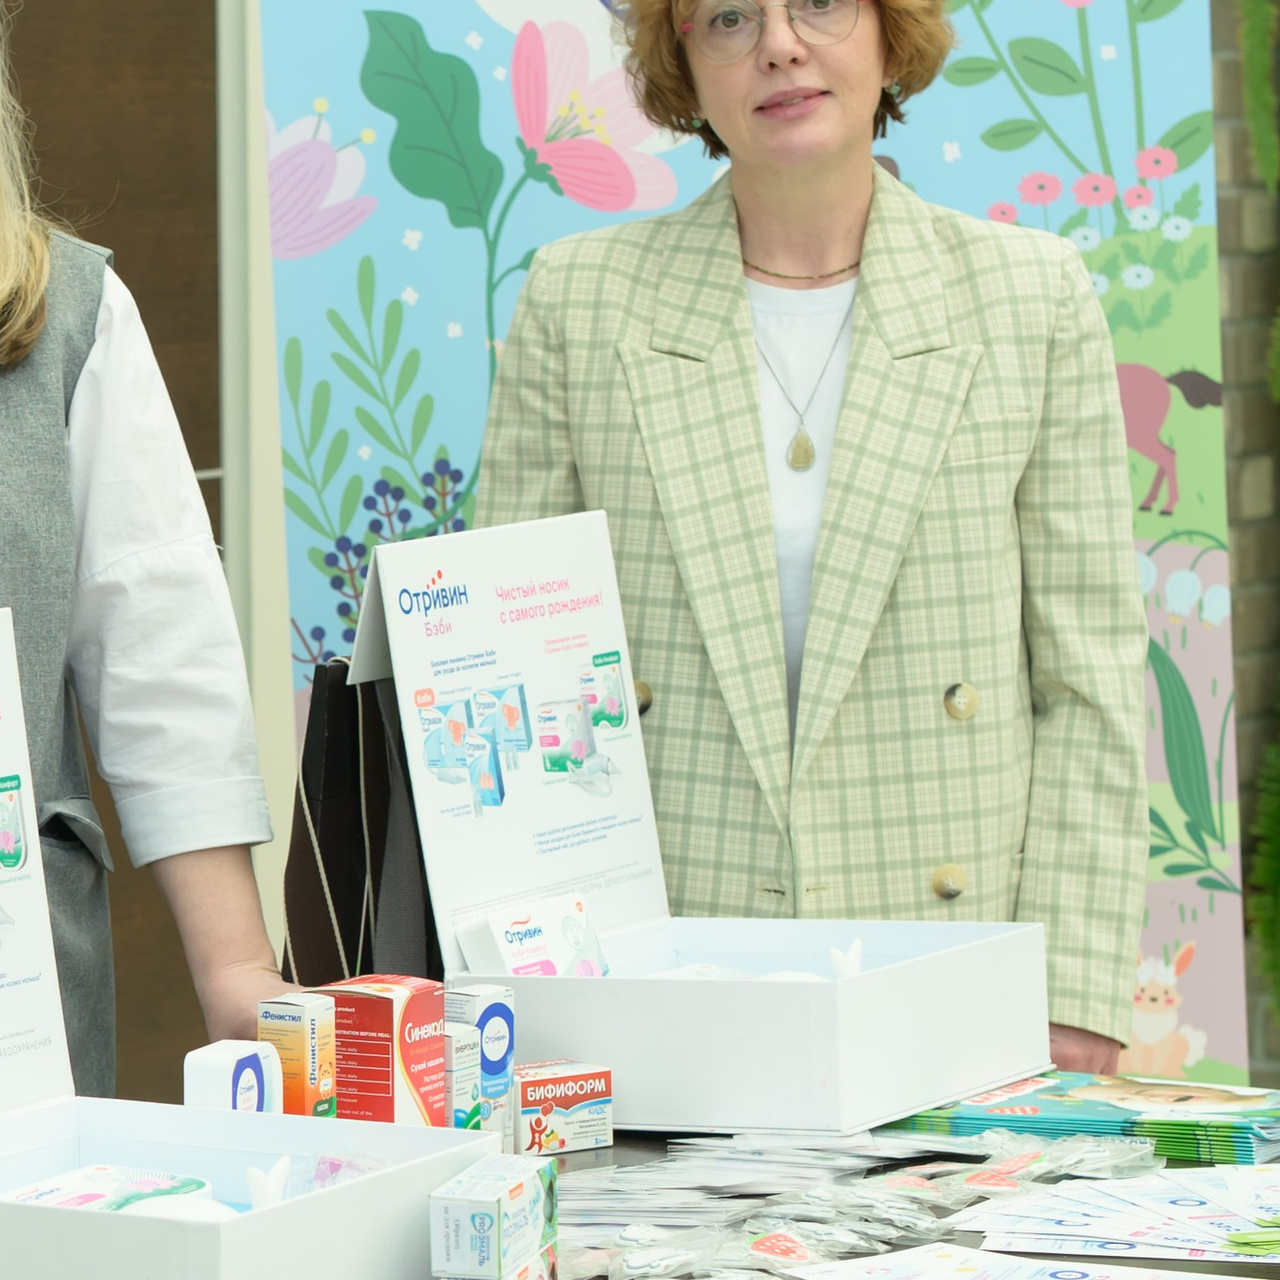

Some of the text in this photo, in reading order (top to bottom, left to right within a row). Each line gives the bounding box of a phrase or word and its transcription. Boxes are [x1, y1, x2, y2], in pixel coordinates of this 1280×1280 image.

[398, 582, 469, 617] Отривин
[495, 577, 571, 603] Чистый носик
[508, 604, 546, 623] самого
[548, 590, 604, 619] рождения!
[424, 619, 453, 638] Бэби
[504, 925, 544, 946] Отривин
[261, 1010, 302, 1023] Фенистил
[404, 1018, 445, 1043] Синекод
[309, 1017, 317, 1086] Фенистил
[526, 1077, 606, 1102] БИФИФОРМ
